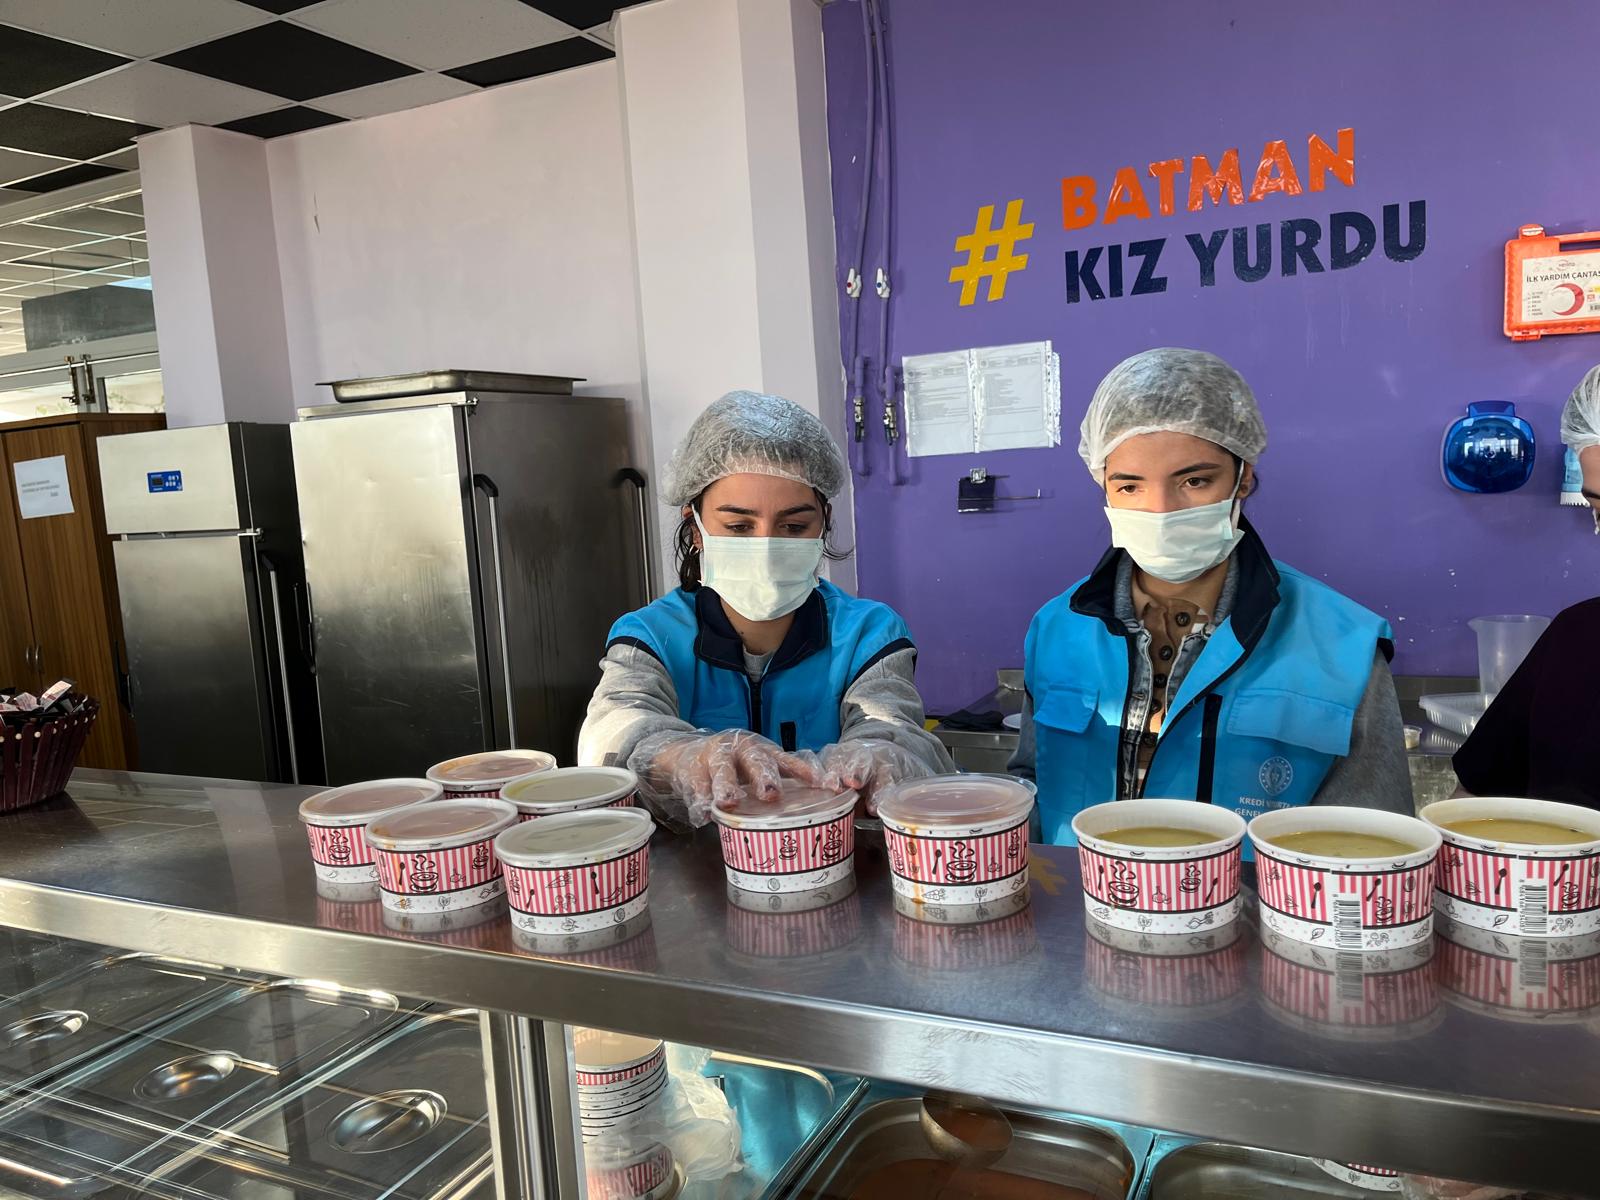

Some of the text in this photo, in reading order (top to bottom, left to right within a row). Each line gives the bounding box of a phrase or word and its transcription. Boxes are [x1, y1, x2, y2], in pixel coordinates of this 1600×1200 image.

[1061, 127, 1355, 230] BATMAN
[1064, 200, 1426, 304] KIZ YURDU
[1526, 274, 1538, 283] İLK
[1540, 272, 1570, 282] YARDIM
